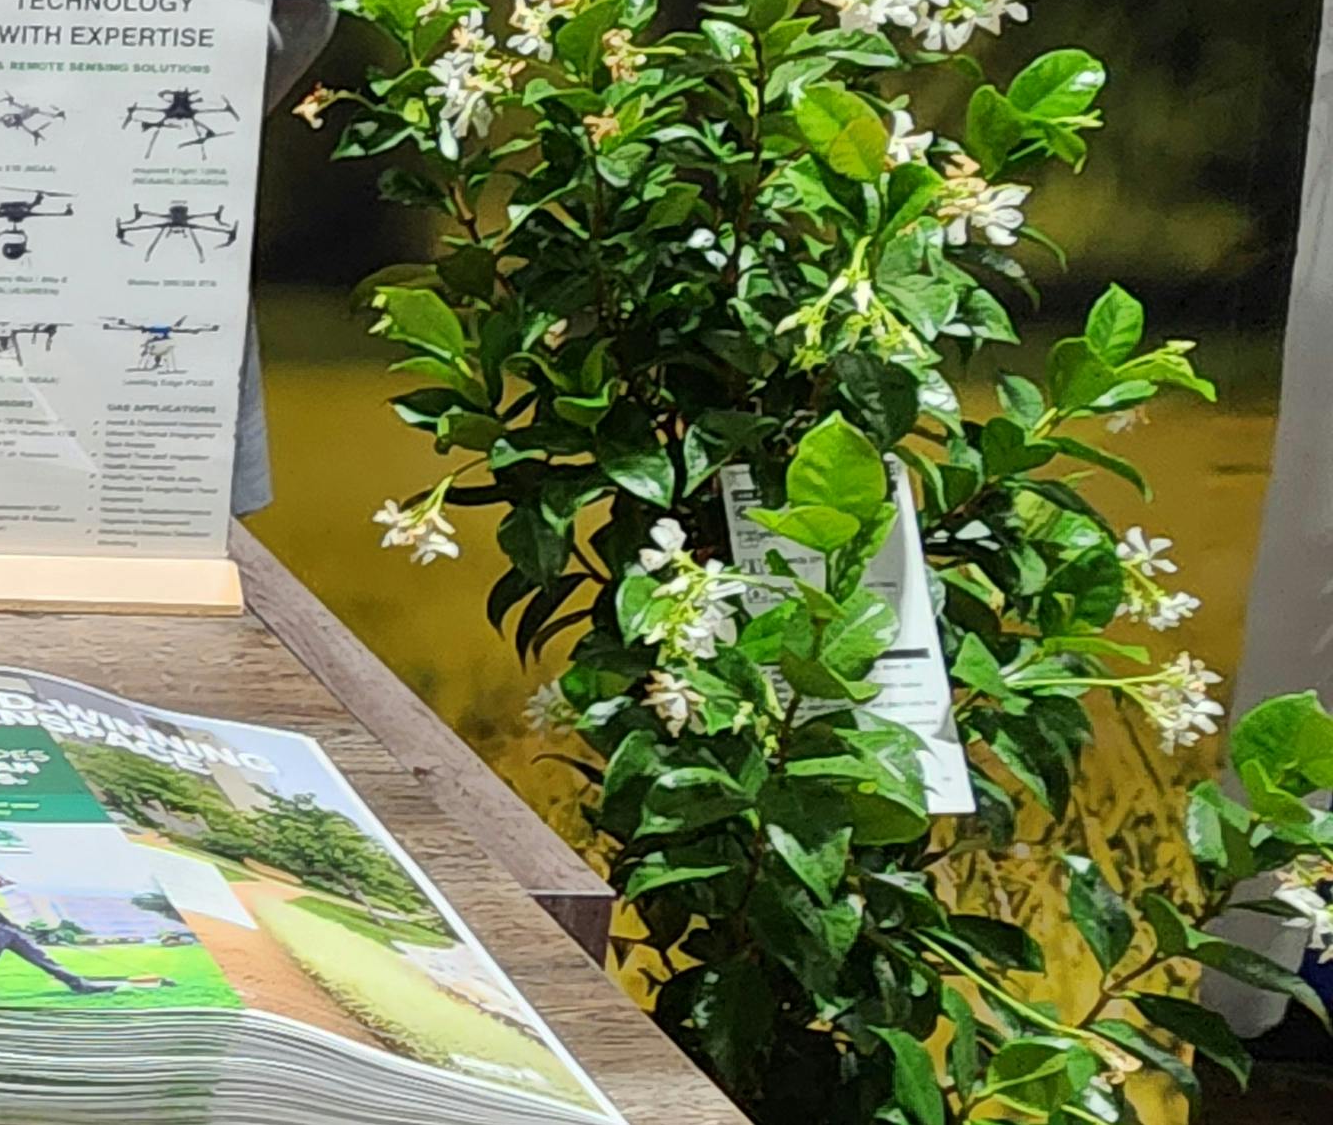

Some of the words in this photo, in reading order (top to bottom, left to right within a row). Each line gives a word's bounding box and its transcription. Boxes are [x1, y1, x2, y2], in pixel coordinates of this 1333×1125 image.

[69, 26, 215, 48] EXPERTISE
[9, 60, 65, 72] REMOTE
[69, 61, 130, 73] SENSING
[133, 62, 211, 74] SOLUTIONS
